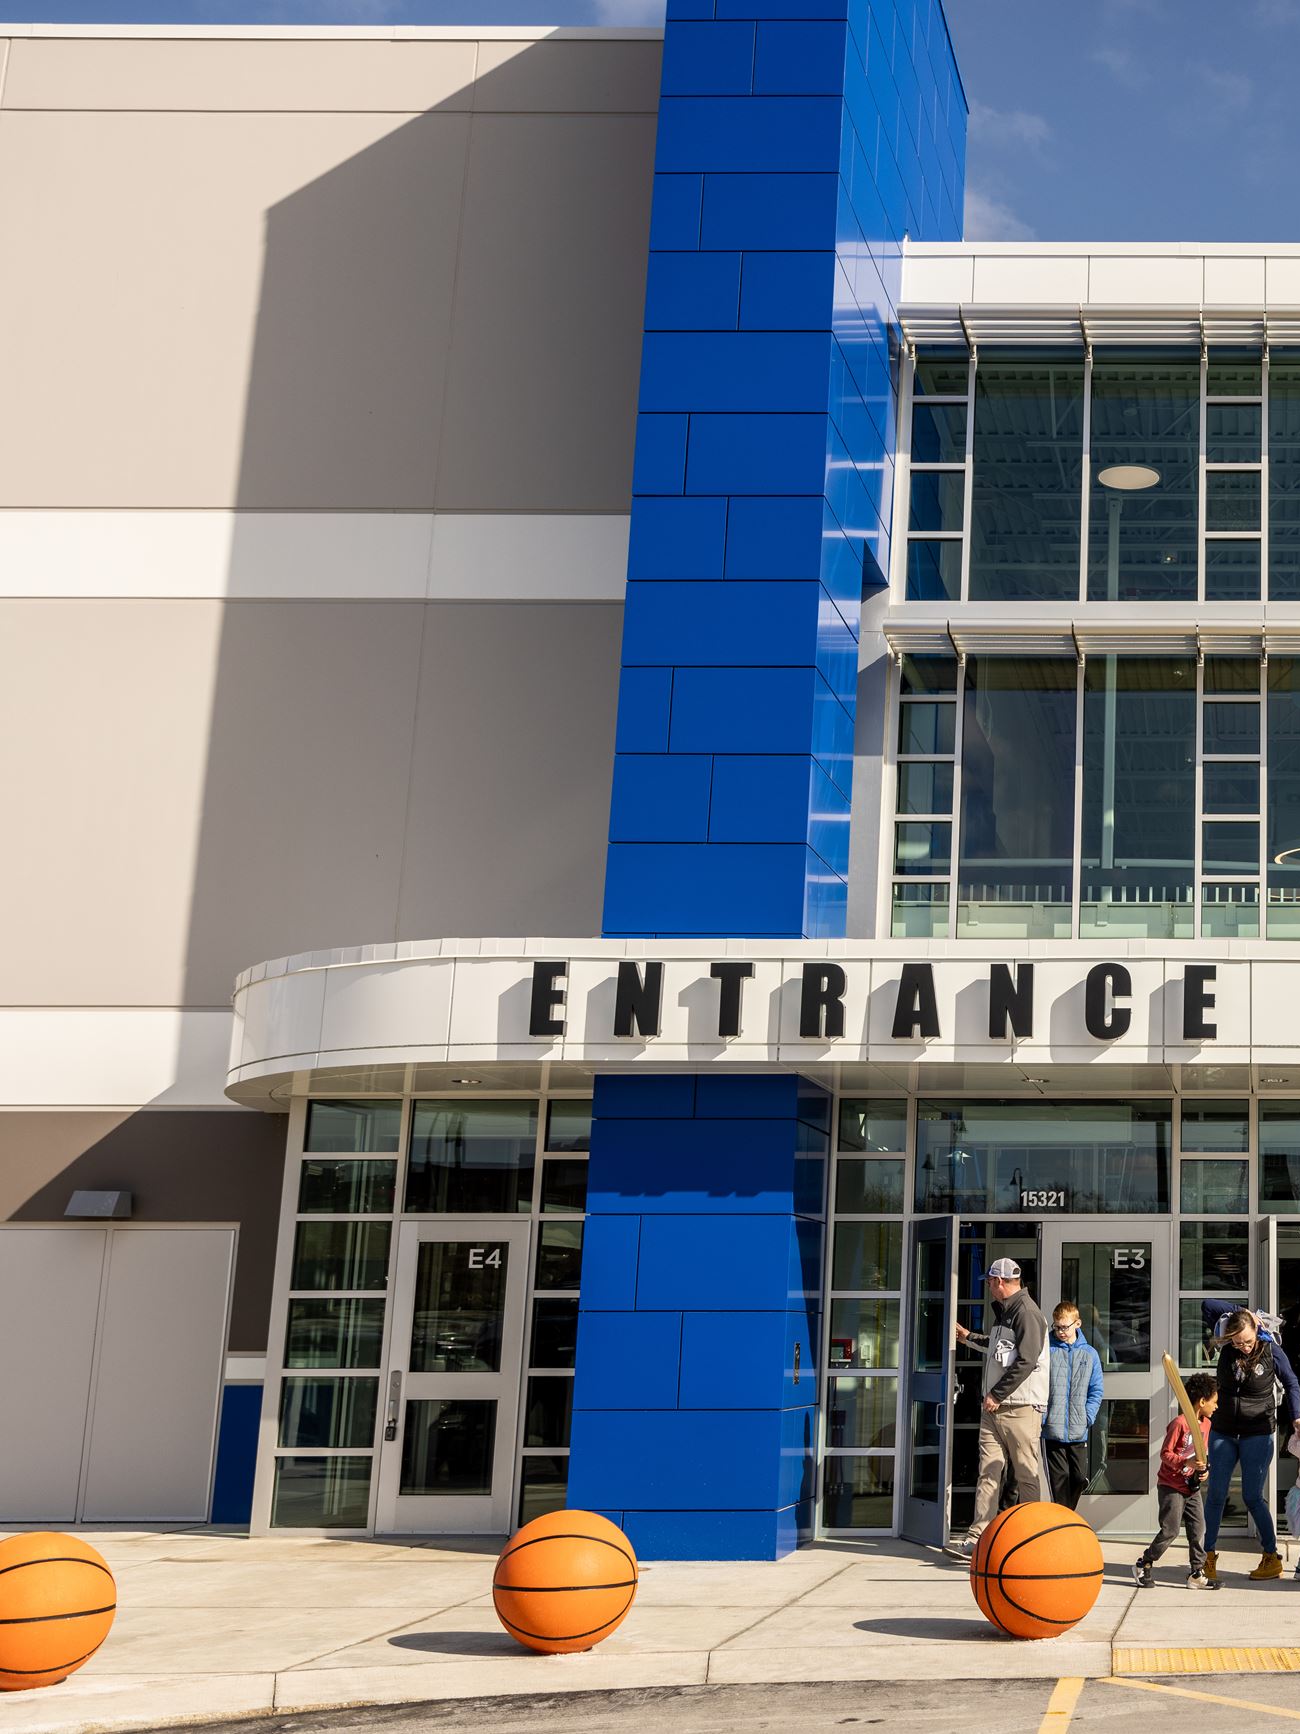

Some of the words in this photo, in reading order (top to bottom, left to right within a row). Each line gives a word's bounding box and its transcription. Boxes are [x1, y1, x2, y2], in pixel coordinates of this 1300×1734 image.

[529, 962, 1218, 1041] ENTRANCE
[1020, 1191, 1065, 1207] 15321
[468, 1248, 502, 1269] E4
[1114, 1248, 1145, 1269] E3
